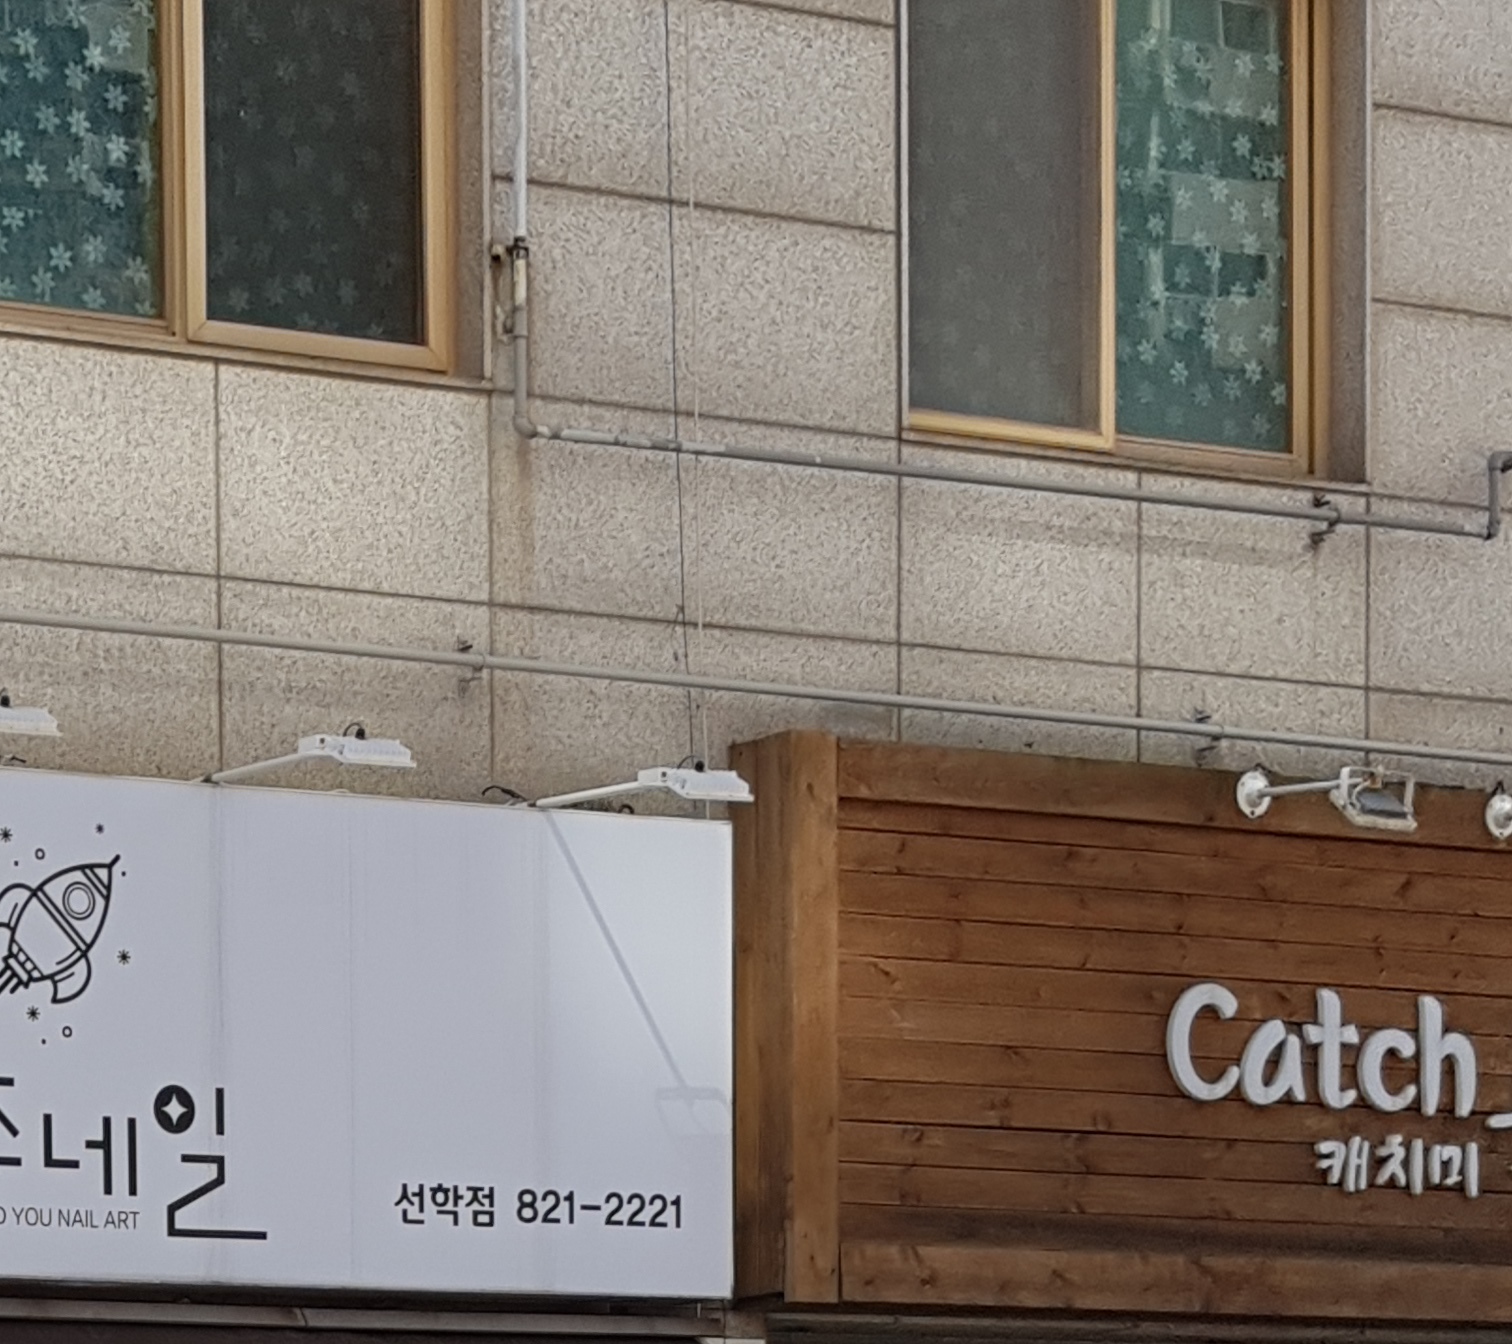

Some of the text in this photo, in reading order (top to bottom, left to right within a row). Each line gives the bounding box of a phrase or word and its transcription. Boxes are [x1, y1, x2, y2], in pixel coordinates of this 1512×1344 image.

[1313, 1134, 1480, 1199] 캐치미
[12, 1206, 52, 1227] YOU
[58, 1208, 99, 1229] NAIL
[103, 1210, 140, 1230] ART
[394, 1182, 684, 1229] 선학점 821-2221
